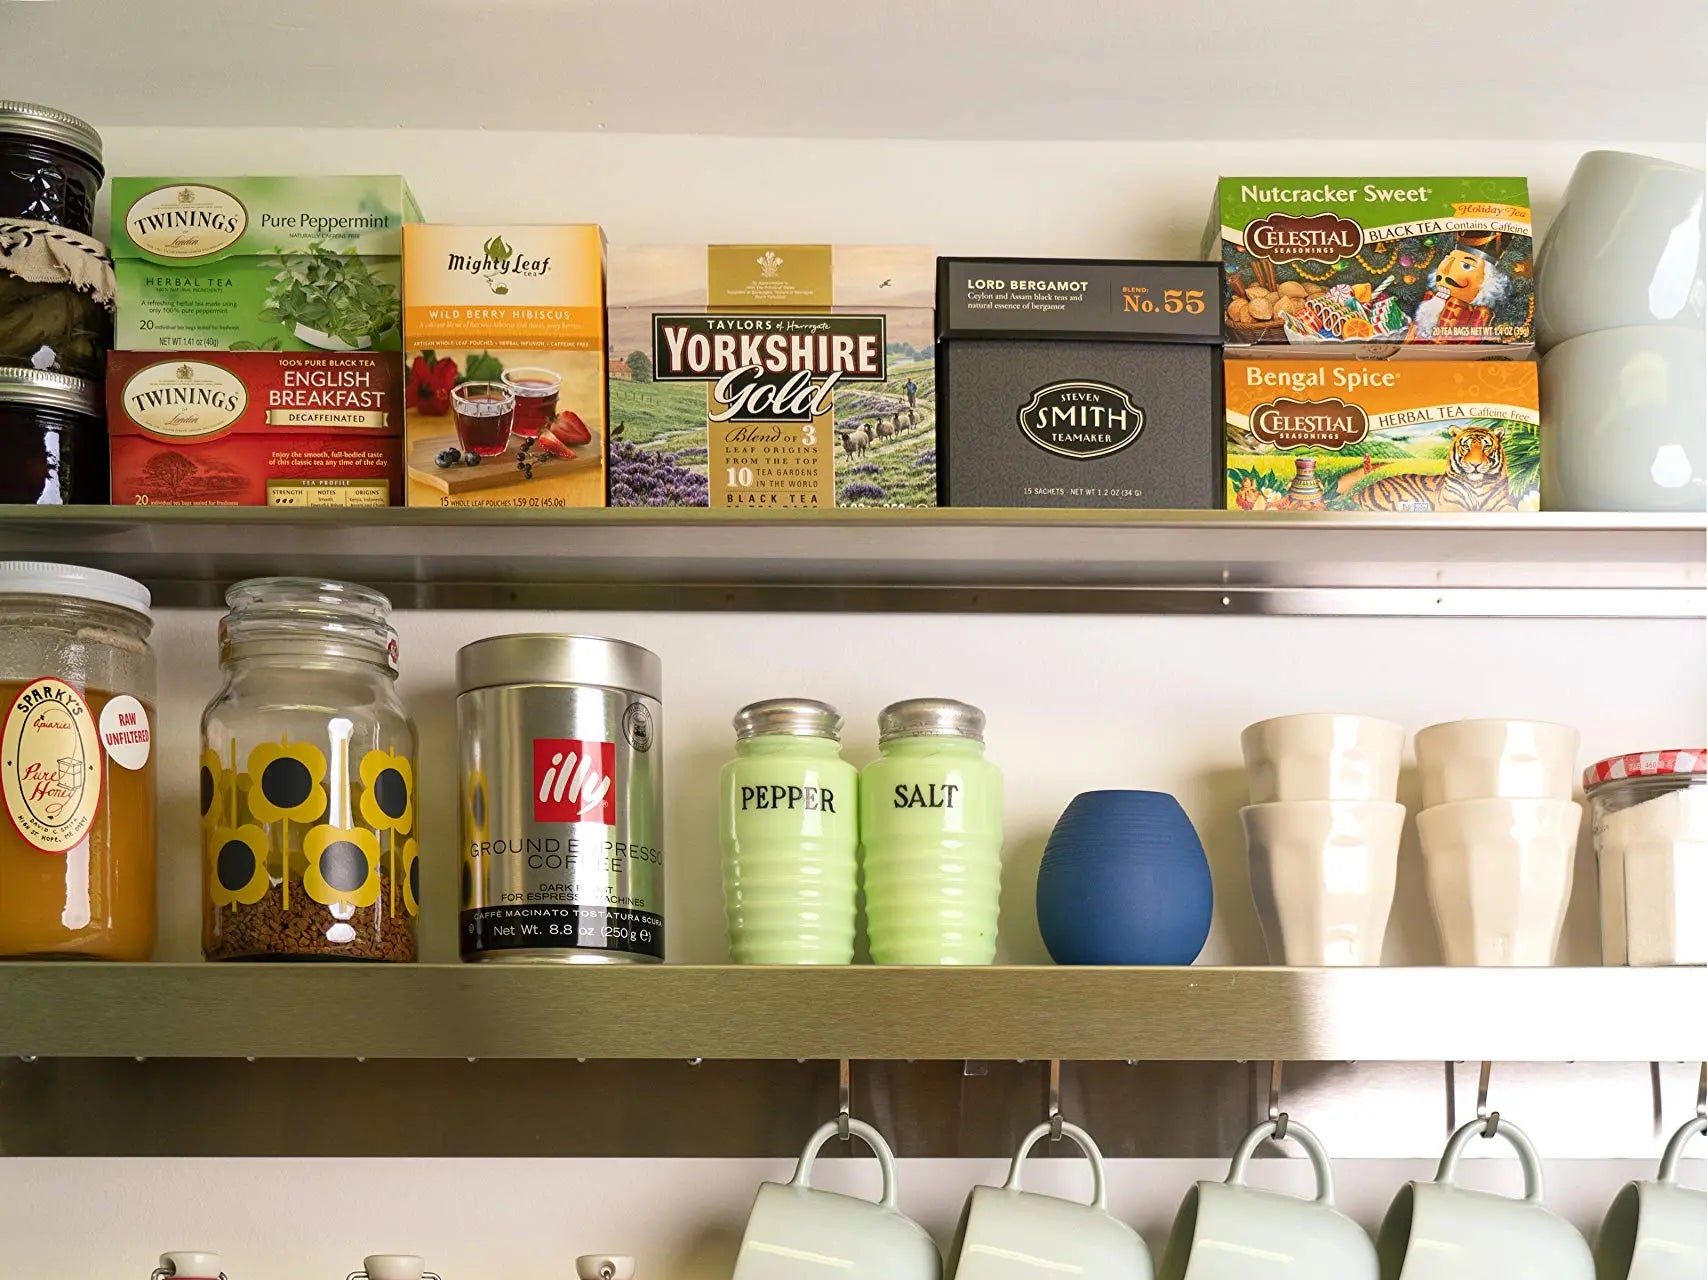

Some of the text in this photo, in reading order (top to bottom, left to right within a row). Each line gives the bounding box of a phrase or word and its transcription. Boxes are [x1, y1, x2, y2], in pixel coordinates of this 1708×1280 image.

[1241, 184, 1428, 203] Nutcracker Sweet
[1458, 204, 1527, 218] Holiday Tea
[134, 210, 238, 235] TWININGS
[261, 213, 389, 232] Pure Peppermint
[1253, 224, 1354, 250] CELESTIAL
[1368, 221, 1529, 242] BLACK TEA Contains Caffeine
[1274, 246, 1334, 255] SEASONINGS
[447, 253, 551, 276] Mighty Leaf
[146, 277, 233, 287] HERBAL TEA
[967, 279, 1089, 292] LORD BERGAMOT
[967, 291, 994, 302] Ceylon
[994, 292, 1008, 300] and
[1010, 292, 1033, 301] Assam
[1034, 293, 1052, 301] black
[1123, 289, 1205, 314] No. 55
[967, 301, 993, 309] natural
[1022, 302, 1030, 310] of
[1031, 302, 1066, 312] bergamot
[428, 309, 571, 320] WILD BERRY HIBISCUS
[139, 319, 154, 330] 20
[706, 319, 831, 334] TAYLORS of Harrogate
[1432, 326, 1513, 336] 20 TEA BAGS NET WT OZ
[159, 337, 170, 346] NET
[172, 337, 182, 346] WT
[183, 337, 195, 346] 1.41
[662, 324, 879, 374] YORKSHIRE
[279, 359, 302, 367] 100%
[304, 359, 327, 367] PURE
[284, 370, 370, 388] ENGLISH
[1246, 366, 1395, 392] Bengal Spice
[131, 387, 239, 412] TWININGS
[269, 389, 386, 408] BREAKFAST
[708, 364, 844, 422] Gold
[1060, 392, 1100, 402] STEVEN
[288, 413, 365, 423] DECAFFEINATED
[1036, 406, 1127, 431] SMITH
[1259, 410, 1358, 435] CELESTIAL
[1378, 406, 1530, 428] HERBAL TEA Caffeine Free
[725, 424, 816, 446] Blend OF 3
[1051, 433, 1112, 443] TEAMAKER
[1279, 432, 1339, 441] SEASONINGS
[272, 451, 289, 459] Enjoy
[303, 451, 330, 459] smooth,
[725, 446, 818, 454] LEAF ORIGINS
[375, 459, 389, 467] day.
[725, 457, 818, 465] FROM THE TOP
[726, 466, 754, 488] 10
[756, 468, 818, 476] TEA GARDENS
[756, 480, 818, 488] IN THE WORLD
[727, 494, 818, 503] BLACK TEA
[1023, 487, 1120, 497] 15 SACHETS NET WT OZ
[135, 494, 149, 506] 20
[440, 496, 539, 507] 15 WHOLE LEAF POUCHES 1.59 OZ
[17, 686, 84, 716] SPARKY'S
[33, 718, 72, 733] Apiaries
[118, 712, 136, 727] RAW
[105, 728, 150, 746] UNFILTERED
[22, 762, 61, 782] Pure
[29, 780, 76, 801] Honey
[539, 751, 611, 816] illy
[741, 785, 836, 814] PEPPER
[893, 782, 959, 809] SALT
[470, 838, 560, 858] GROUND
[539, 883, 573, 892] DARK
[501, 893, 524, 902] FOR
[505, 908, 569, 918] MACINATO
[573, 909, 640, 922] TOSTATURA
[641, 915, 663, 928] SCURA
[493, 924, 595, 936] Net Wt. 8.8 oz
